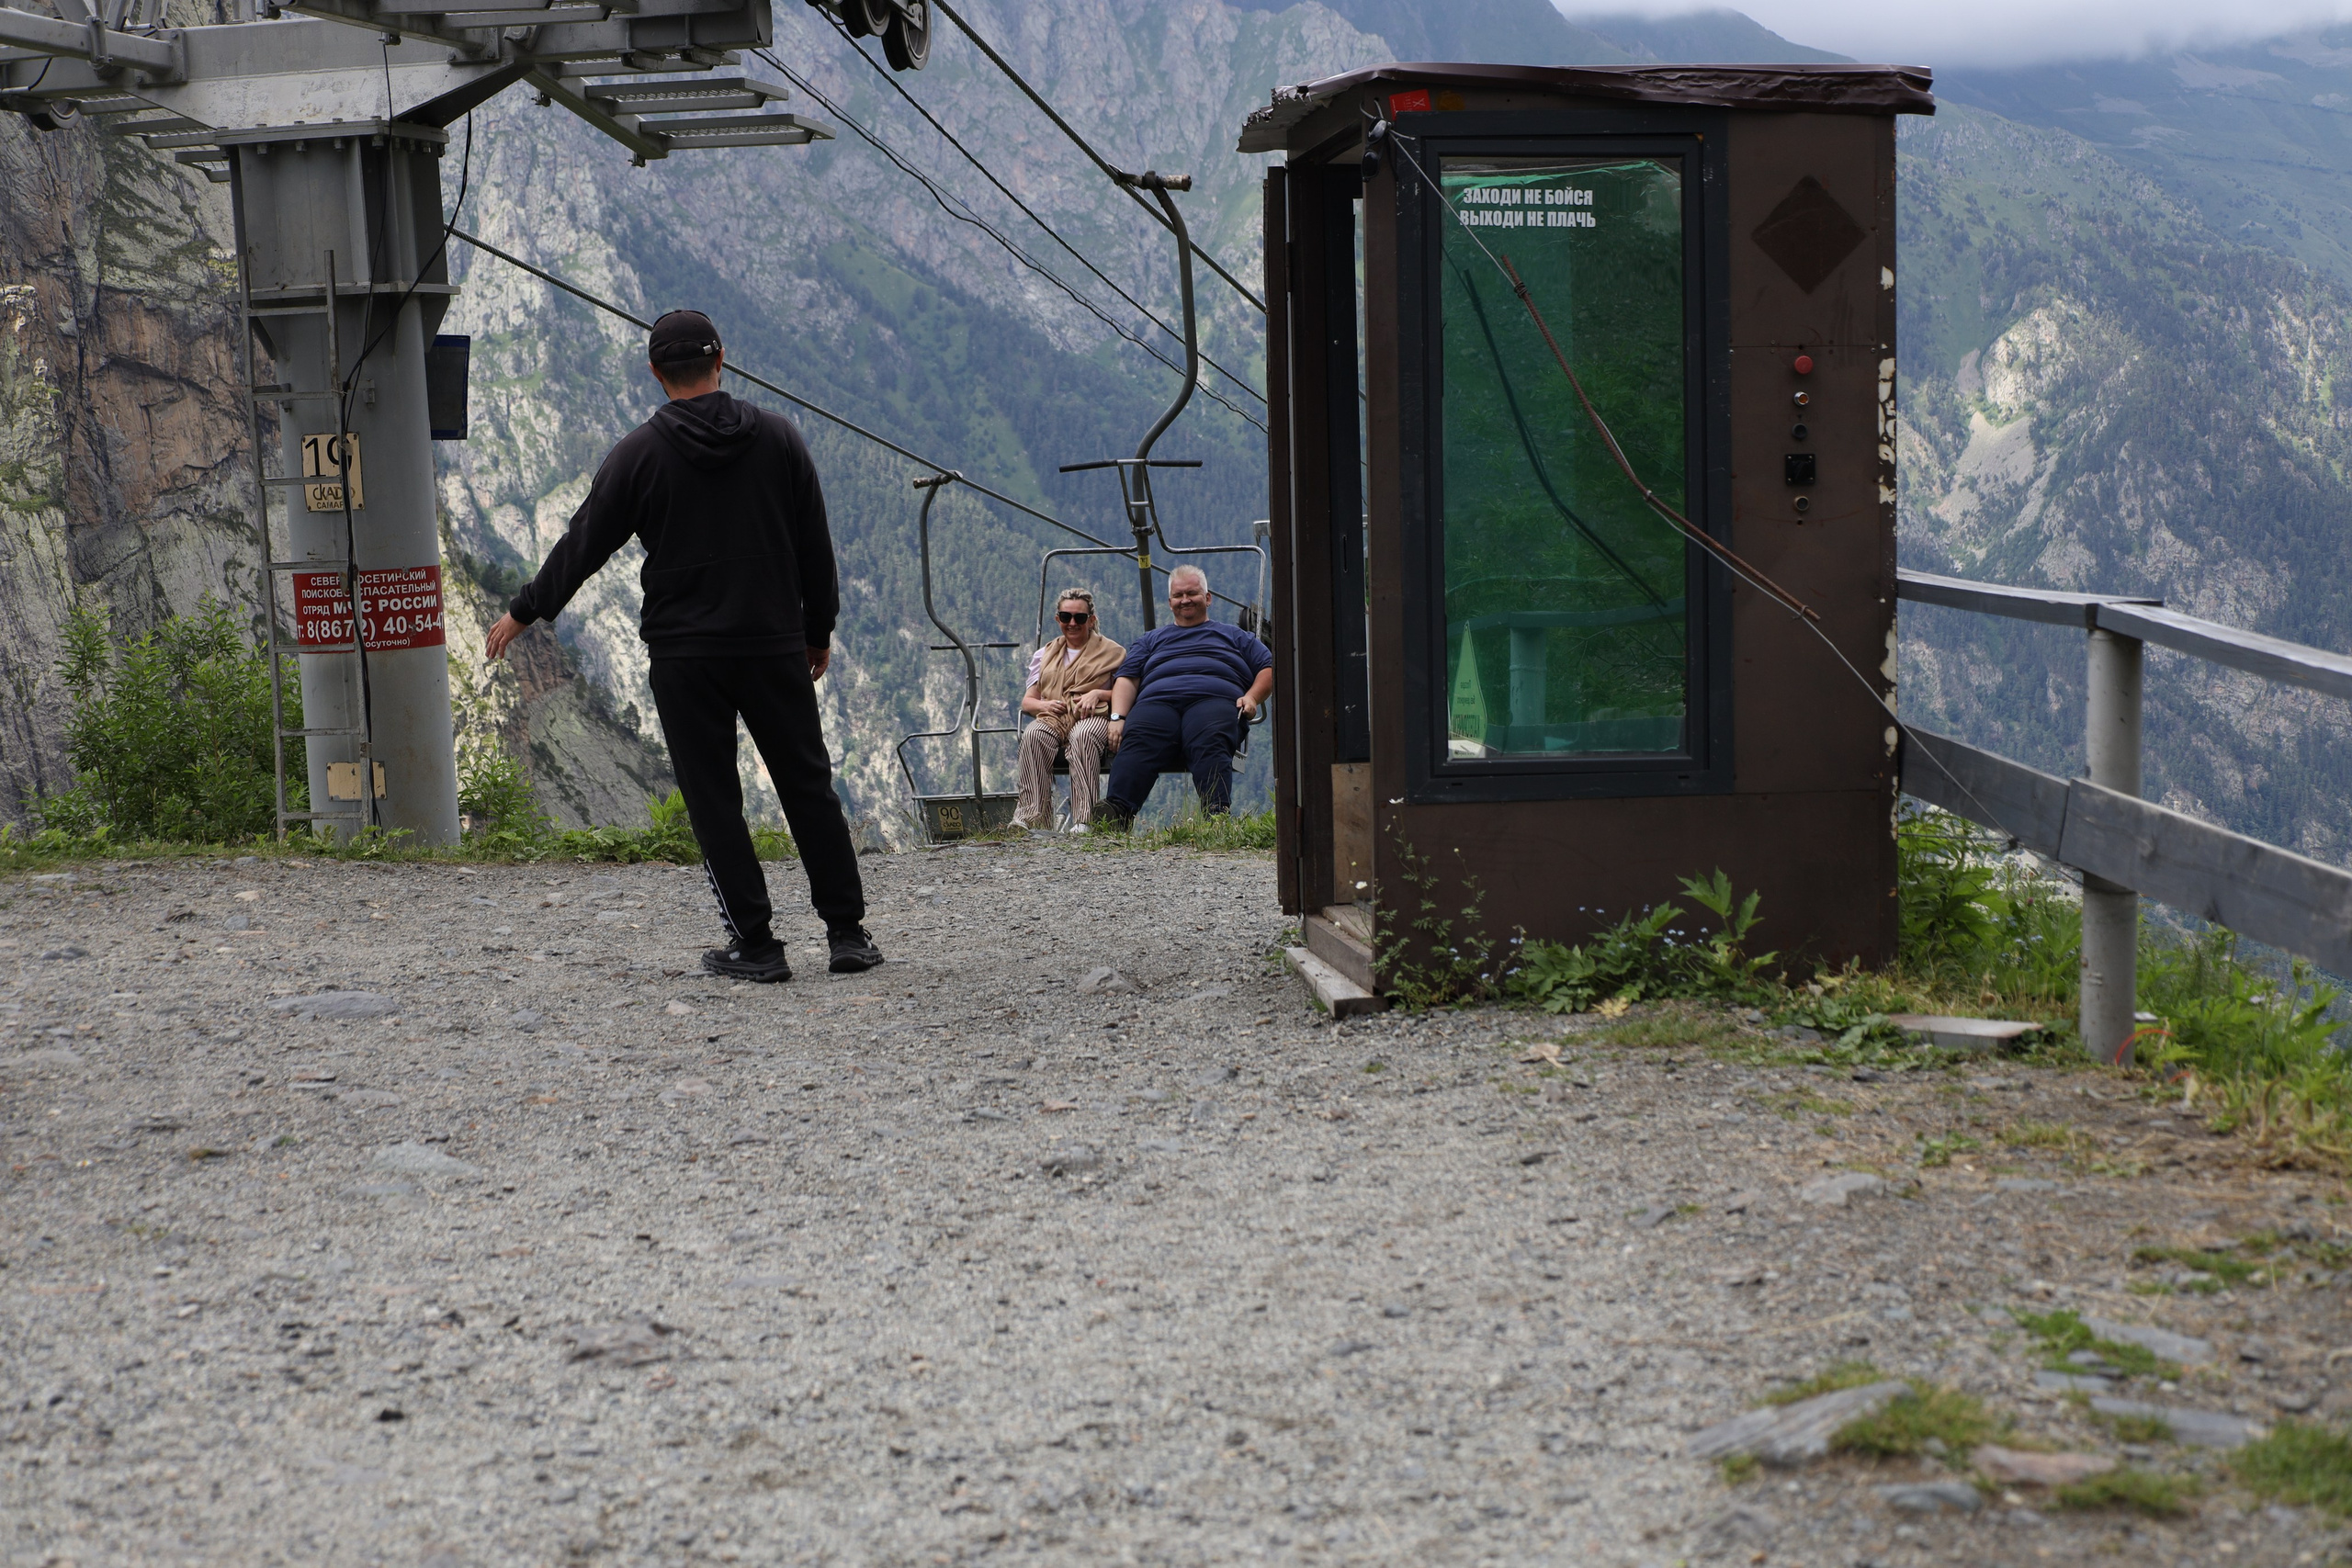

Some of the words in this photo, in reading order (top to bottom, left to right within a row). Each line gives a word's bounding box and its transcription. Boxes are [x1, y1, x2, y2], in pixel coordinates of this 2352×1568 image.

[1463, 187, 1521, 206] ЗАХОДИ
[1524, 188, 1542, 204] НЕ
[1544, 186, 1593, 206] БОЙСЯ
[1460, 209, 1523, 229] ВЫХОДИ
[1527, 210, 1544, 227] НЕ
[1547, 211, 1597, 228] ПЛАЧЬ
[379, 594, 437, 612] РОССИИ
[940, 807, 959, 820] 90
